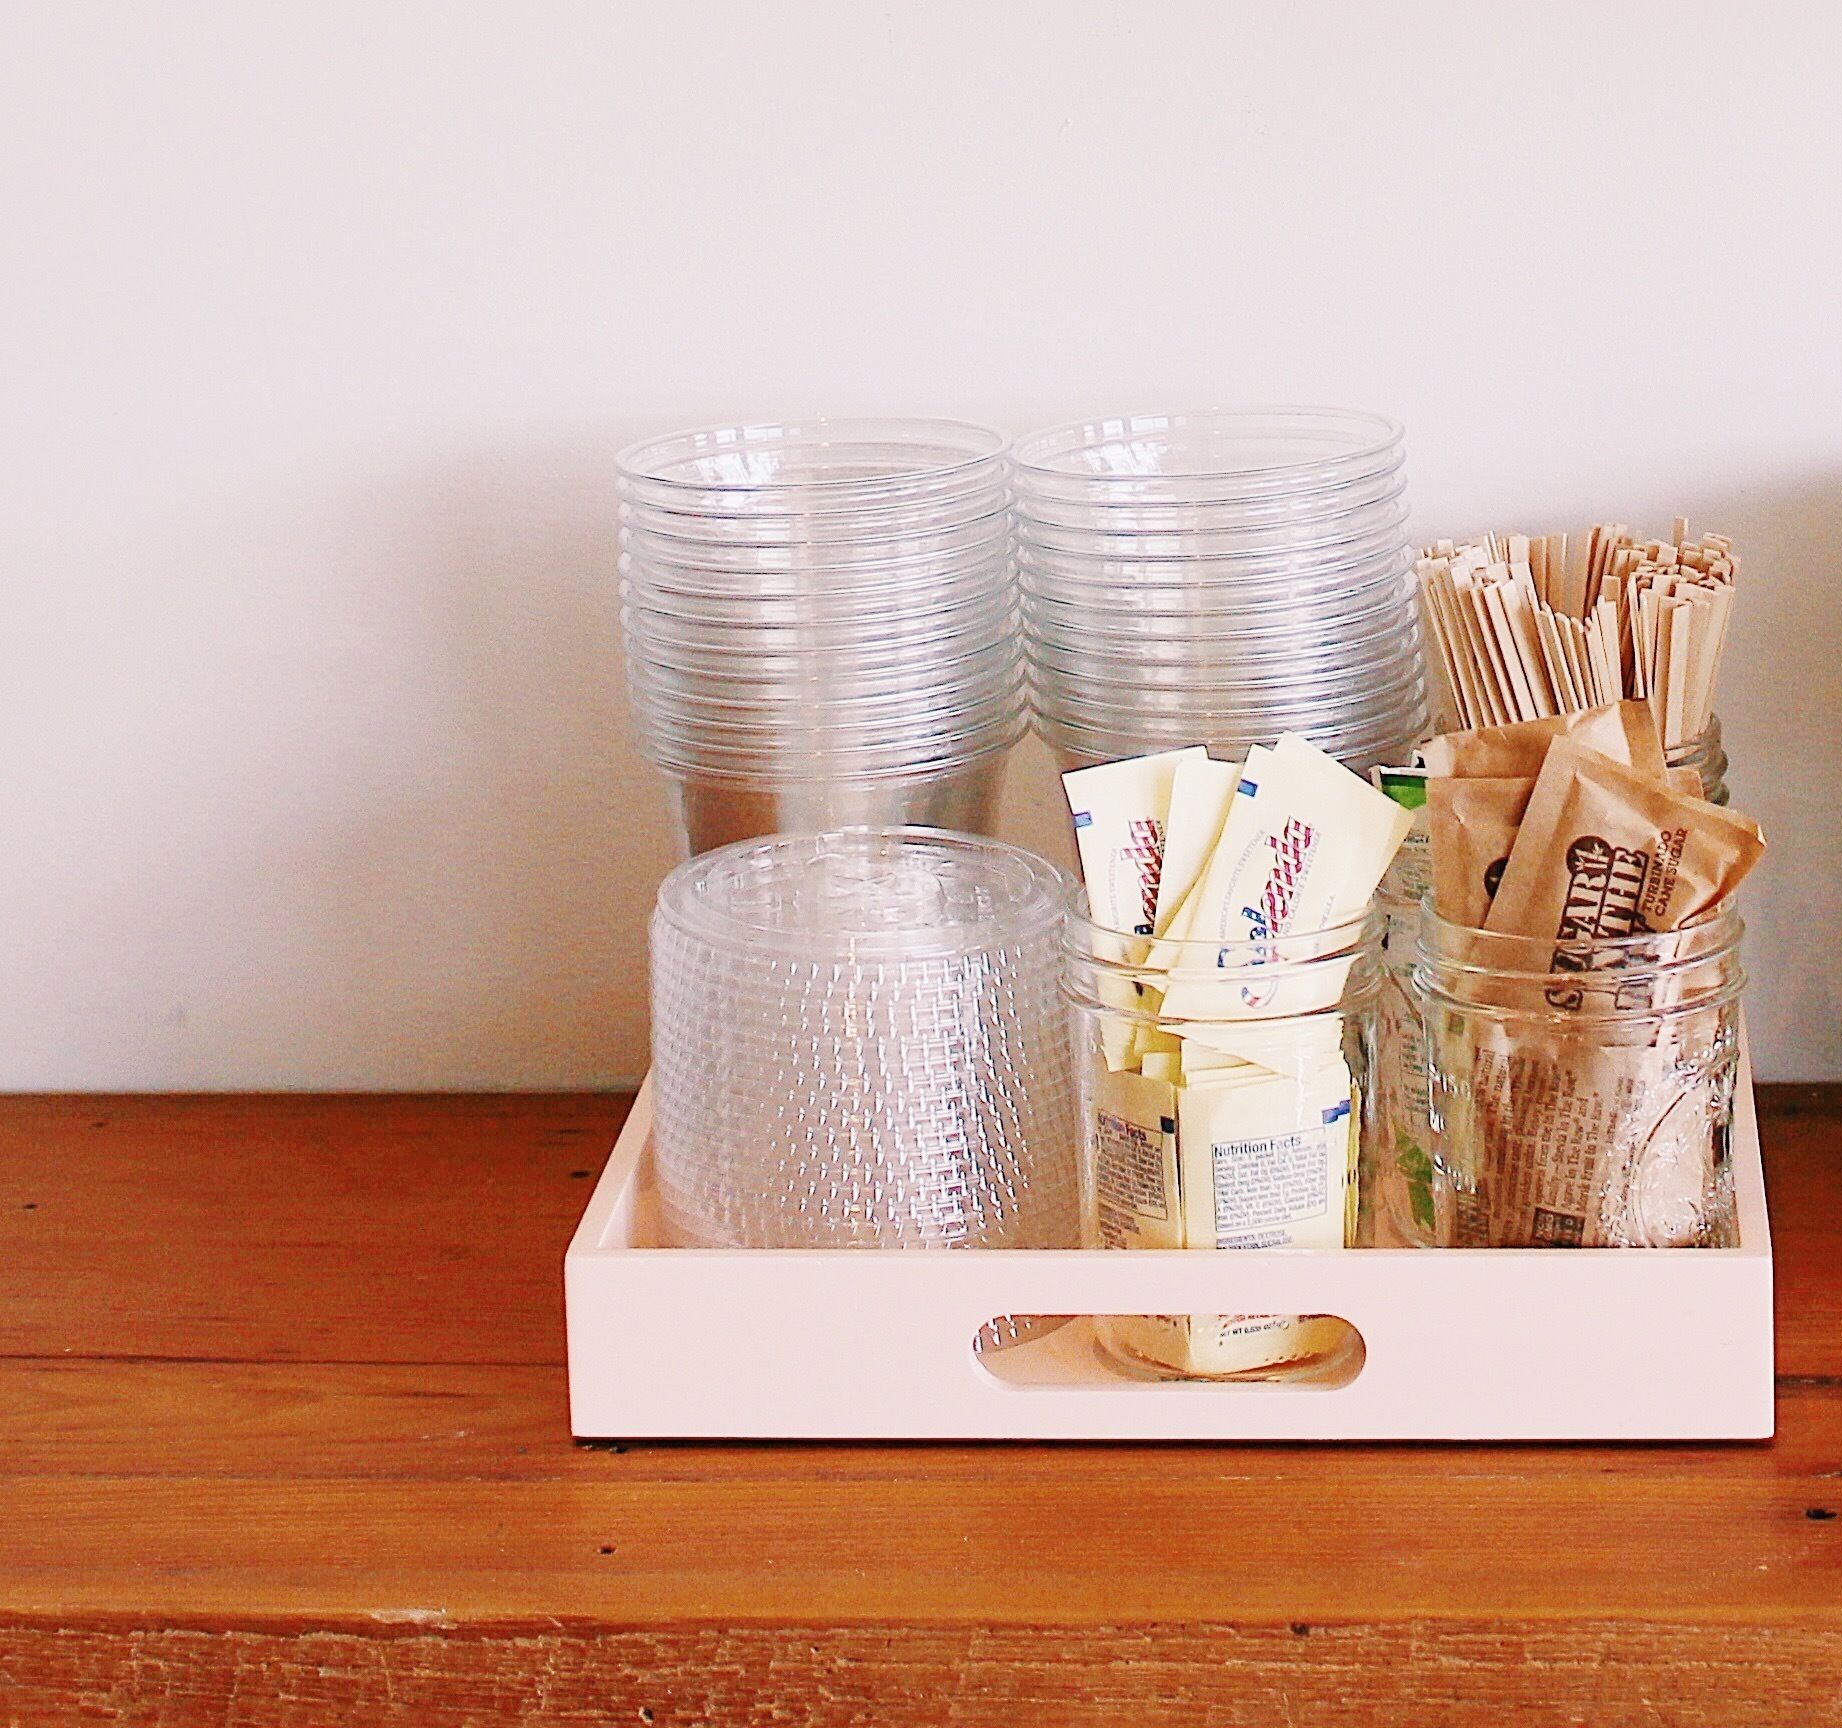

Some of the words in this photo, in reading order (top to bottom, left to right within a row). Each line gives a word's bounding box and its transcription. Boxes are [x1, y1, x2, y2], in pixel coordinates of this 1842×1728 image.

[1596, 849, 1648, 938] THE
[1643, 830, 1671, 911] TURBINADO
[1655, 876, 1675, 917] CANE
[1667, 828, 1688, 875] SUGAR
[1214, 1141, 1267, 1158] Nutrition
[1270, 1135, 1301, 1152] Facts
